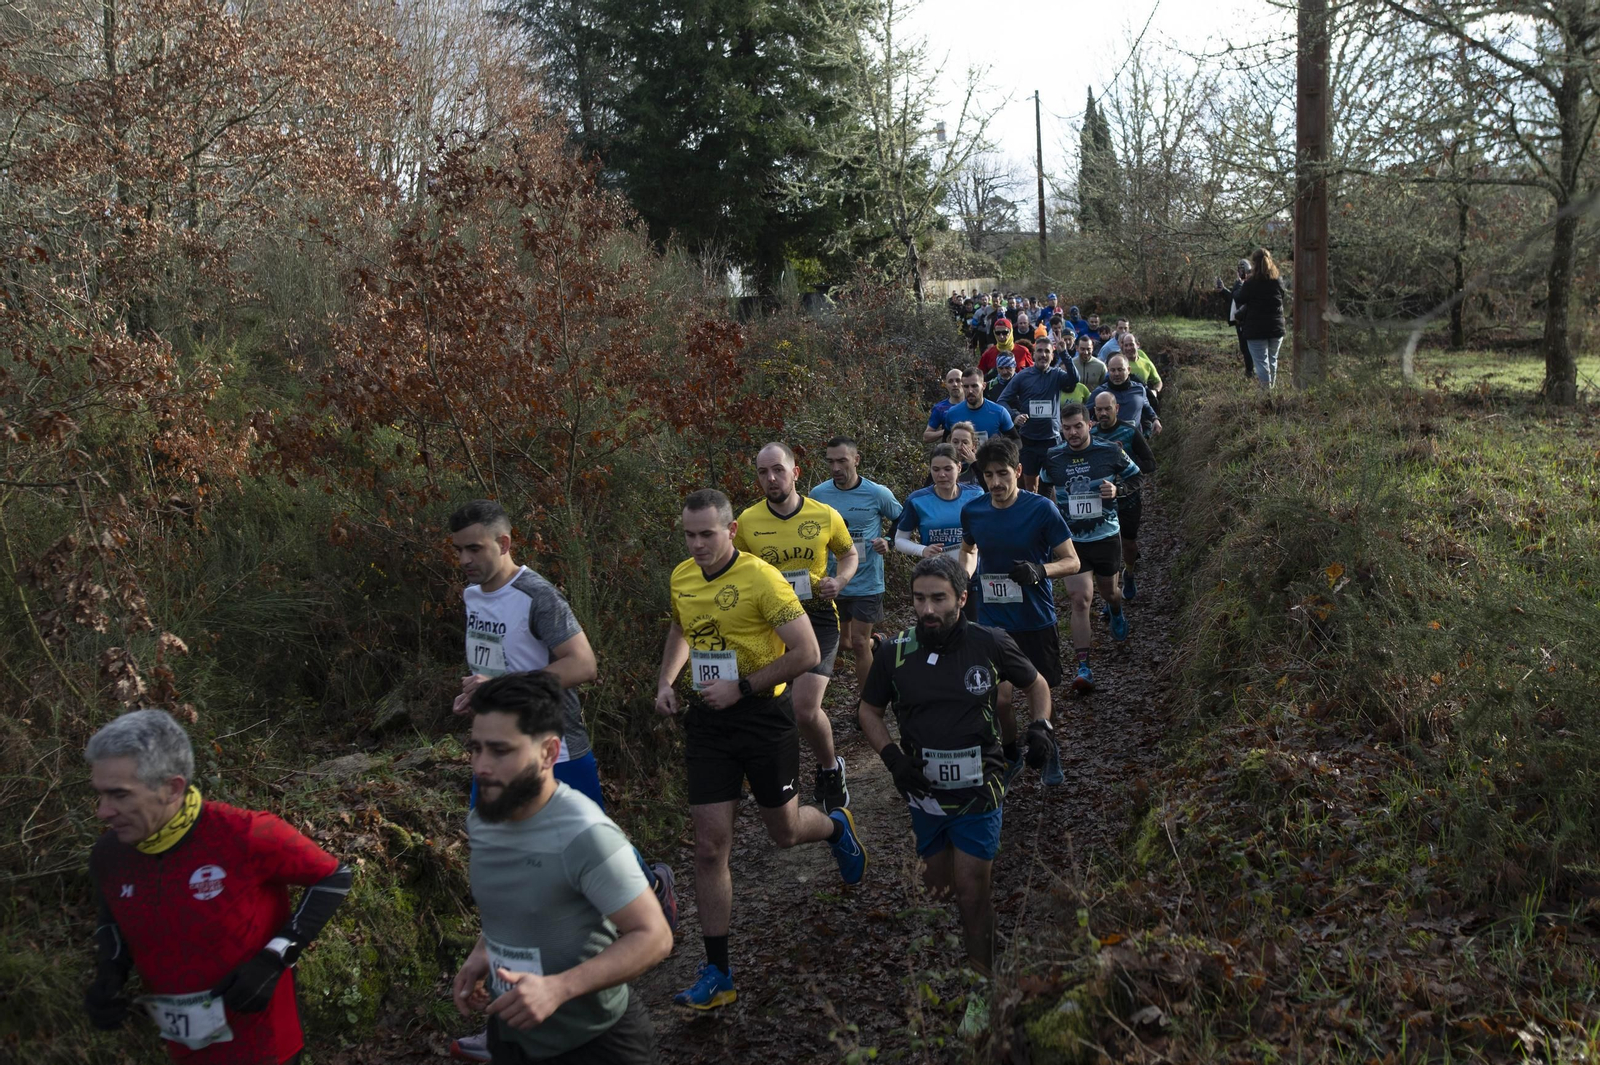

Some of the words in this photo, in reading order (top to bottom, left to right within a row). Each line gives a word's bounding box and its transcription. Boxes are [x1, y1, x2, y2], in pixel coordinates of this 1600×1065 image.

[1035, 406, 1044, 414] 117
[1077, 503, 1092, 514] 170
[783, 547, 815, 561] J.P.D.
[992, 583, 1007, 597] 101
[468, 614, 507, 634] Rianxo
[475, 645, 491, 667] 177
[699, 665, 720, 681] 188
[939, 764, 960, 781] 60
[165, 1012, 189, 1038] 37
